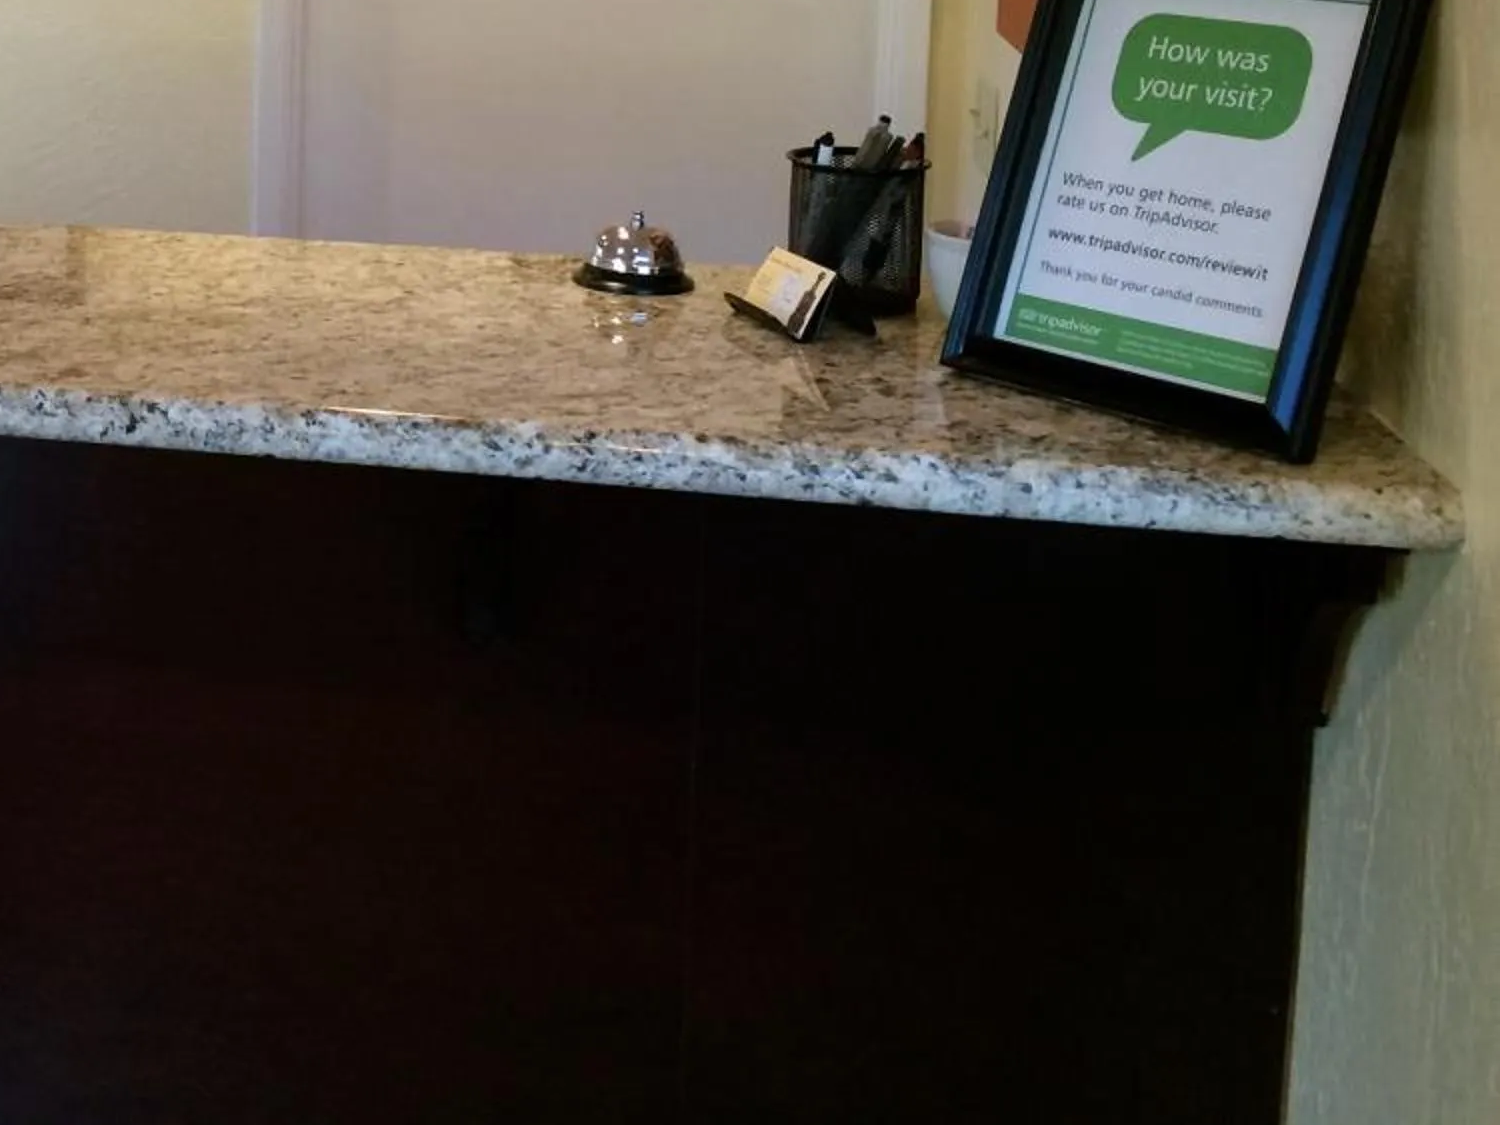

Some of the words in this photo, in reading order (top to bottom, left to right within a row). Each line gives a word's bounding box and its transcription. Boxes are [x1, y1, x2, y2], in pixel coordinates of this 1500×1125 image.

[1148, 35, 1211, 65] How
[1216, 47, 1271, 72] was
[1134, 76, 1198, 102] your
[1205, 81, 1273, 111] visit?
[1057, 193, 1085, 209] rate
[1088, 199, 1106, 213] us
[1109, 203, 1129, 217] on
[1134, 205, 1219, 235] TripAdvisor.
[1062, 172, 1103, 191] When
[1107, 182, 1135, 197] you
[1139, 186, 1164, 203] get
[1167, 190, 1215, 213] home,
[1219, 200, 1272, 222] please
[1048, 227, 1269, 282] www.tripadvisor.com/reviewit
[1040, 259, 1073, 281] Thank
[1074, 269, 1098, 285] you
[1101, 272, 1119, 287] for
[1120, 277, 1150, 292] your
[1151, 284, 1194, 303] candid
[1037, 312, 1102, 336] tripadvisor
